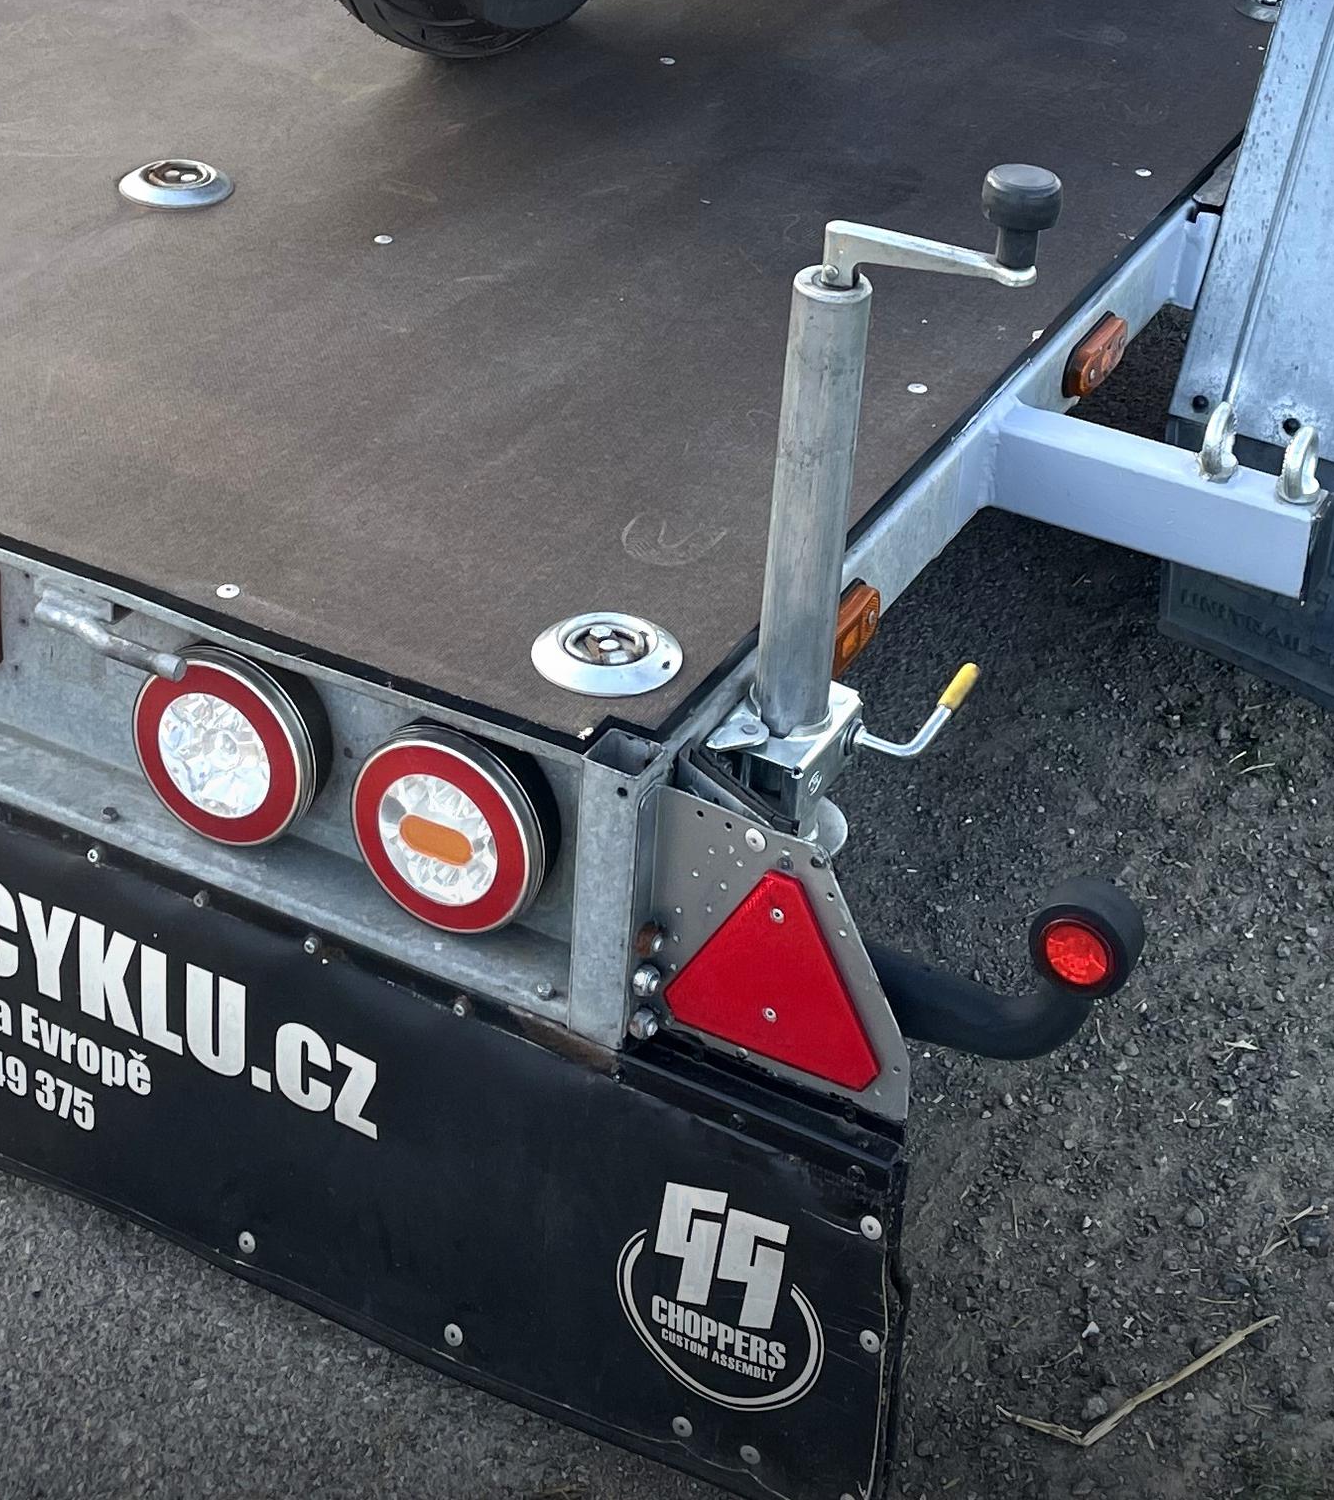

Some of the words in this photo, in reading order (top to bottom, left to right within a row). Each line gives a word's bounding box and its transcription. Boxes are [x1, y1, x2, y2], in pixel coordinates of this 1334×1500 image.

[21, 1008, 152, 1096] Evropě
[35, 1070, 96, 1132] 375
[651, 1294, 787, 1370] CHOPPERS
[660, 1328, 709, 1361] CUSTOM
[710, 1350, 777, 1383] ASSEMBLY
